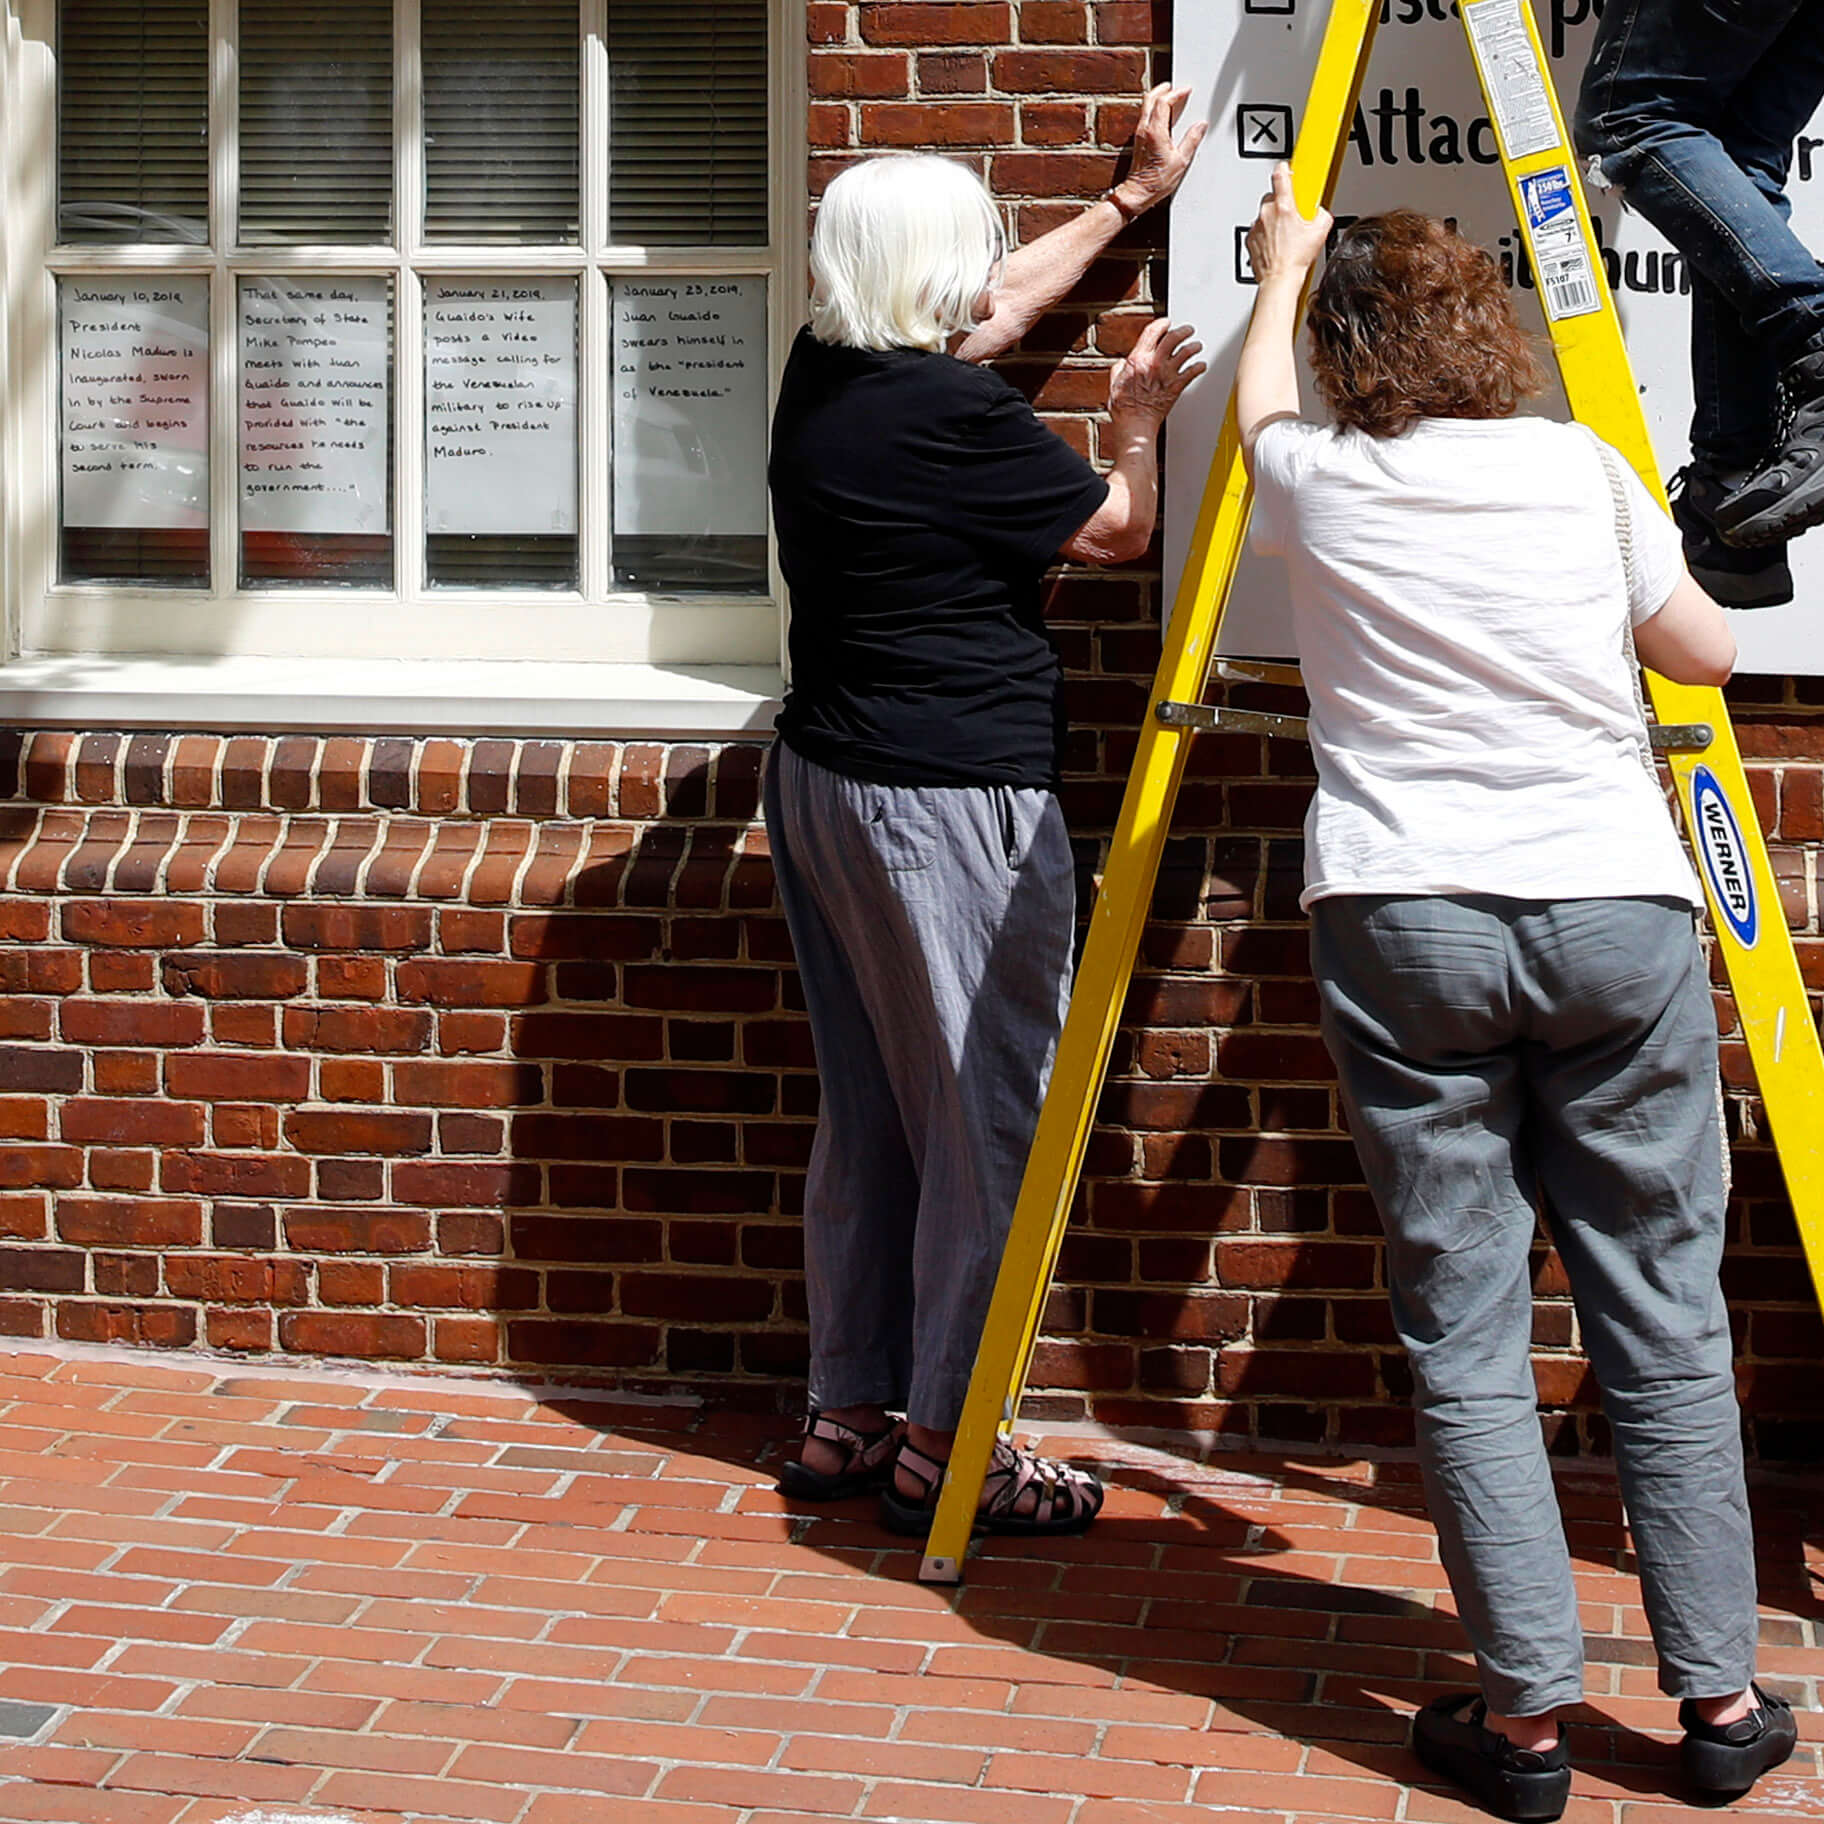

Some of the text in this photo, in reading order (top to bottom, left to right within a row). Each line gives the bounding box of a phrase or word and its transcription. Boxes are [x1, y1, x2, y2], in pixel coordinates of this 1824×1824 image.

[1348, 88, 1501, 166] Attac
[73, 287, 126, 306] January
[437, 288, 485, 300] January
[624, 285, 677, 300] January
[623, 312, 656, 322] Juan
[69, 320, 142, 333] President
[245, 337, 279, 347] Mike
[71, 346, 177, 360] Nicolas Maduro
[489, 420, 550, 431] President
[1704, 802, 1747, 911] WERNER
